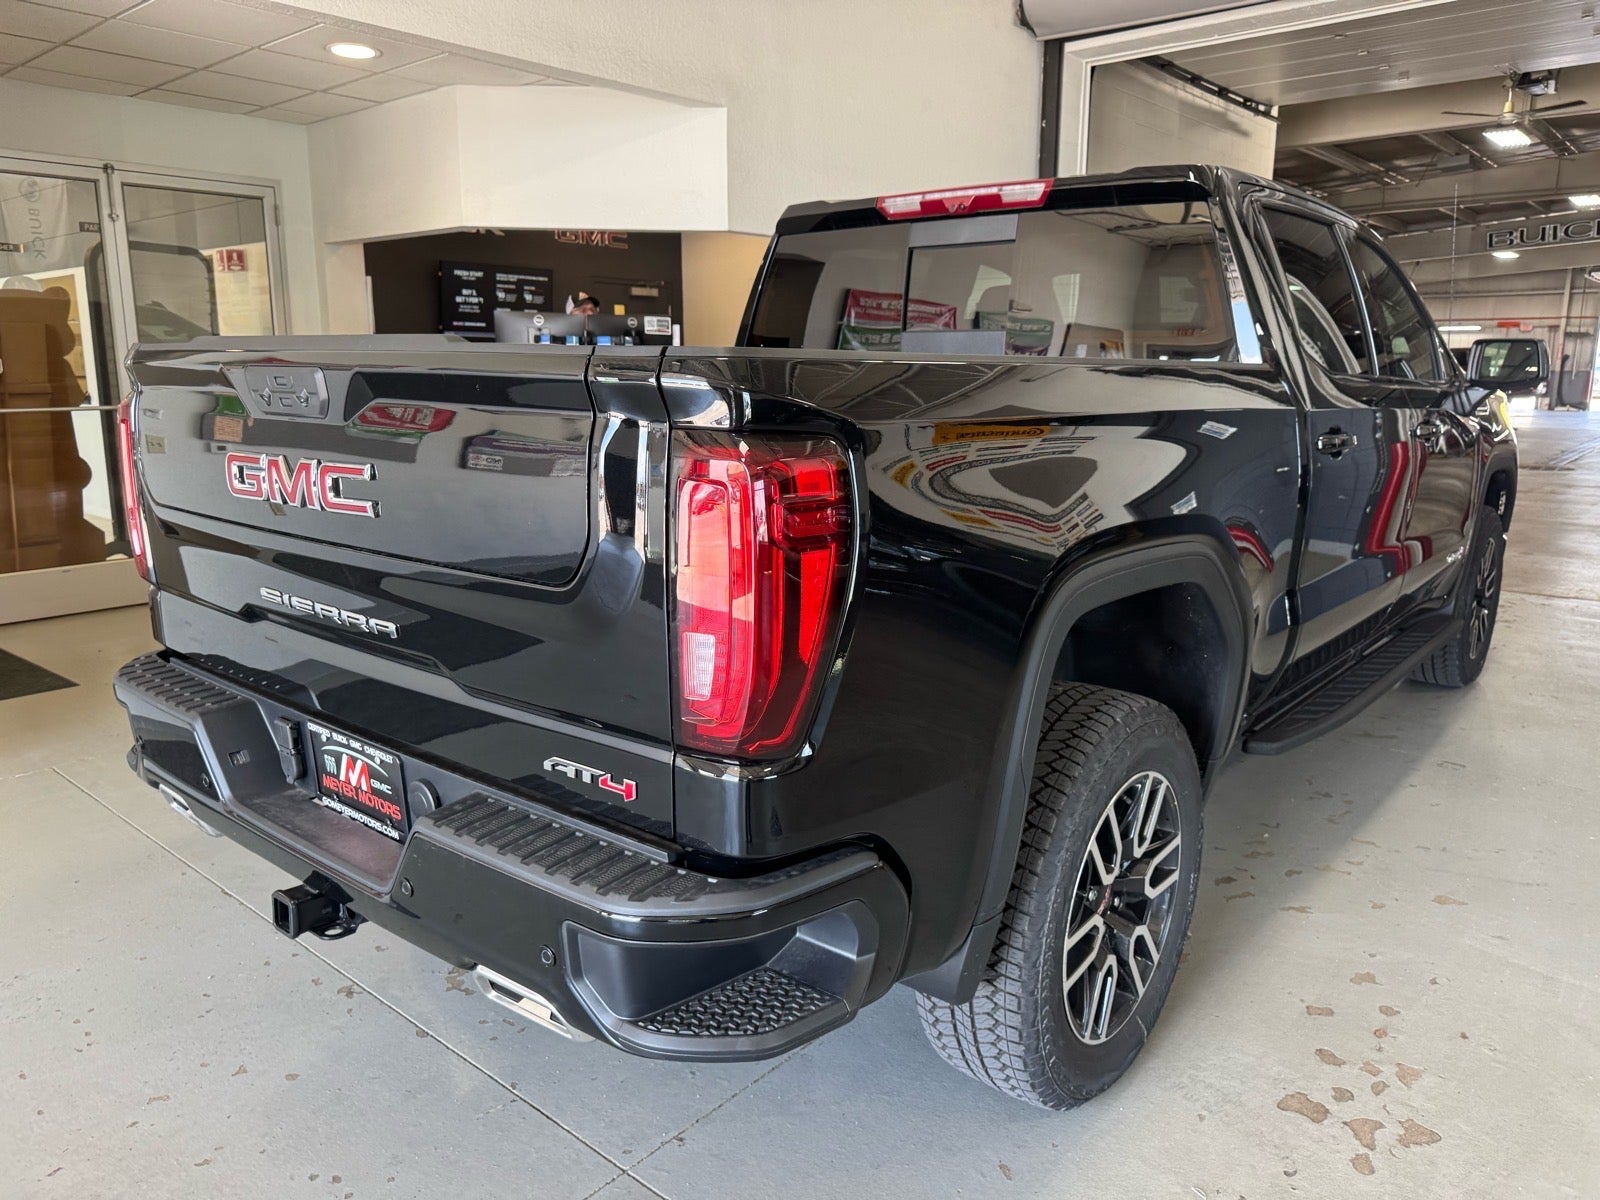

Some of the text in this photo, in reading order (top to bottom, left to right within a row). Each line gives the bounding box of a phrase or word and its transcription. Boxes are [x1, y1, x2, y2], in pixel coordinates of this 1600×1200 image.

[1487, 218, 1600, 250] BUIC
[225, 451, 382, 518] GMC
[259, 586, 401, 639] SIERRA
[322, 774, 402, 821] MEYER MOTORS
[543, 755, 638, 802] AT4
